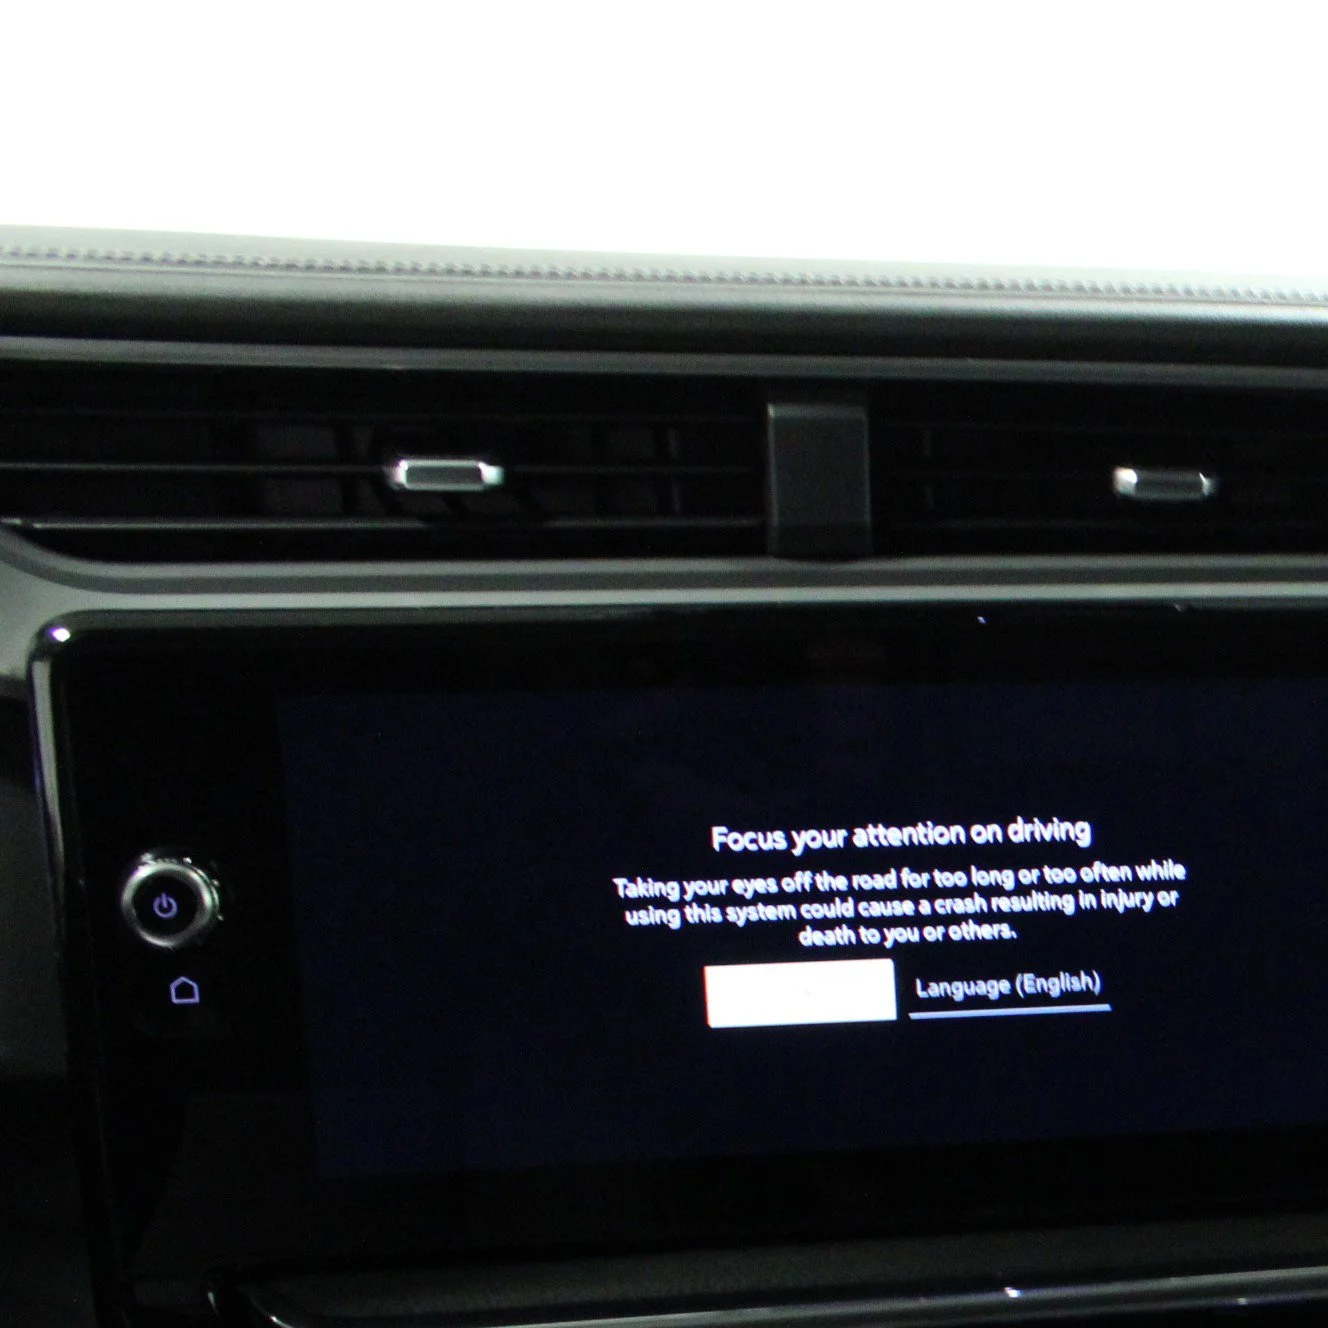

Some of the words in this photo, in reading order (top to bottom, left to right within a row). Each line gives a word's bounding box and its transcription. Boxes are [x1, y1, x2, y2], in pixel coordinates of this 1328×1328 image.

[711, 825, 788, 852] Focus
[790, 828, 849, 857] your
[852, 820, 967, 849] attention
[970, 823, 1003, 845] on
[1006, 815, 1092, 848] driving
[611, 876, 681, 903] Taking
[682, 878, 730, 902] your
[731, 877, 779, 900] eyes
[780, 870, 814, 894] off
[814, 870, 849, 892] the
[852, 867, 898, 891] road
[899, 866, 932, 889] for
[932, 868, 969, 889] too
[970, 864, 1016, 892] long
[1017, 868, 1041, 886] or
[1042, 864, 1078, 885] too
[1079, 860, 1133, 884] often
[1134, 858, 1187, 882] while
[624, 905, 682, 930] using
[683, 901, 724, 924] this
[725, 901, 798, 928] system
[799, 896, 855, 920] could
[857, 899, 916, 918] cause
[917, 898, 932, 916] a
[933, 891, 989, 915] crash
[990, 889, 1076, 916] resulting
[1078, 889, 1098, 910] in
[1099, 887, 1155, 914] injury
[1156, 889, 1180, 908] or
[798, 923, 857, 947] death
[857, 925, 882, 945] to
[882, 926, 921, 949] you
[922, 925, 947, 943] or
[947, 918, 1018, 941] others.
[915, 977, 1012, 1002] Language
[1015, 969, 1101, 999] (English)
